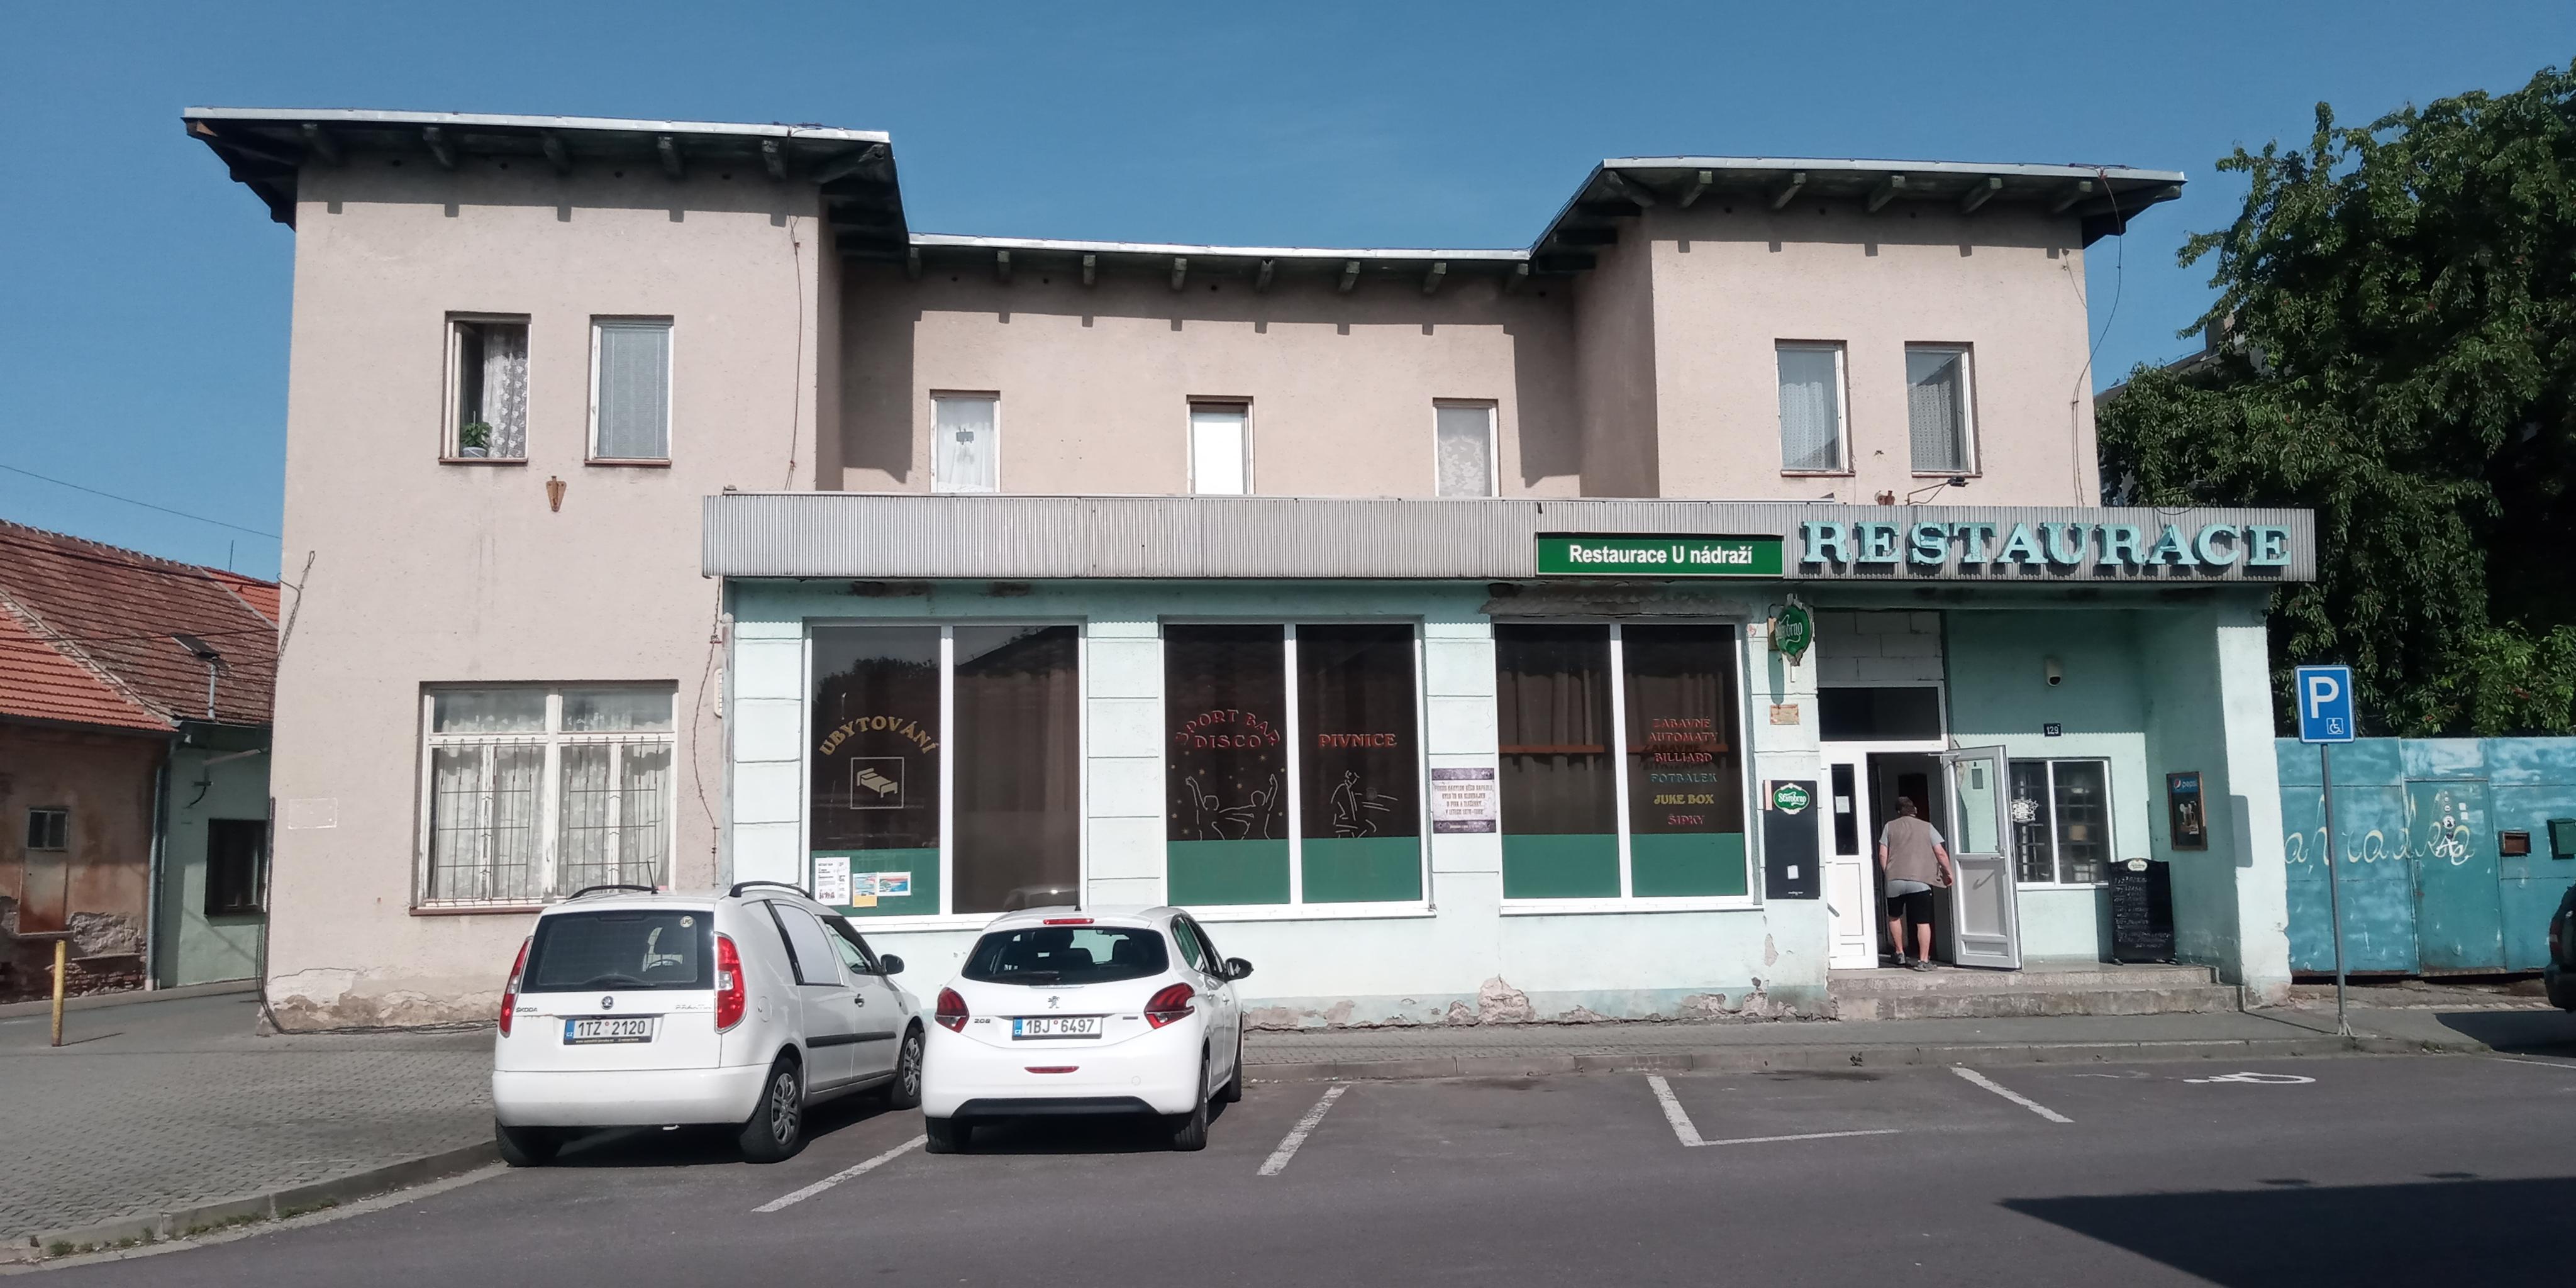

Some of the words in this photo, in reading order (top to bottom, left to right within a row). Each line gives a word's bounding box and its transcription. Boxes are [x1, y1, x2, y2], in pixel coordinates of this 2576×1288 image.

[1801, 520, 2292, 567] RESTAURACE
[1569, 545, 1667, 564] Restaurace
[1672, 545, 1685, 564] U
[1690, 545, 1753, 564] nádraží
[2309, 676, 2340, 719] P
[1174, 709, 1240, 745] SPORT
[1245, 711, 1280, 747] BAR
[1652, 716, 1711, 728] ZÁBAVNÉ
[819, 715, 940, 755] UBYTOVÁNÍ
[1649, 731, 1719, 742] AUTOMATY
[2046, 725, 2060, 735] 129
[1194, 734, 1262, 749] DISCO
[1318, 733, 1397, 748] PIVNICE
[1653, 752, 1713, 763] BILLIARD
[1650, 771, 1718, 783] FOTBÁLEK
[1653, 794, 1686, 805] JUKE
[1687, 794, 1715, 804] BOX
[1778, 791, 1807, 806] Starobrno
[1667, 813, 1706, 825] ŠIPKY
[578, 1021, 602, 1036] 1TZ
[611, 1019, 646, 1036] 2120
[1026, 1019, 1050, 1034] 1BJ
[1060, 1019, 1095, 1033] 6497
